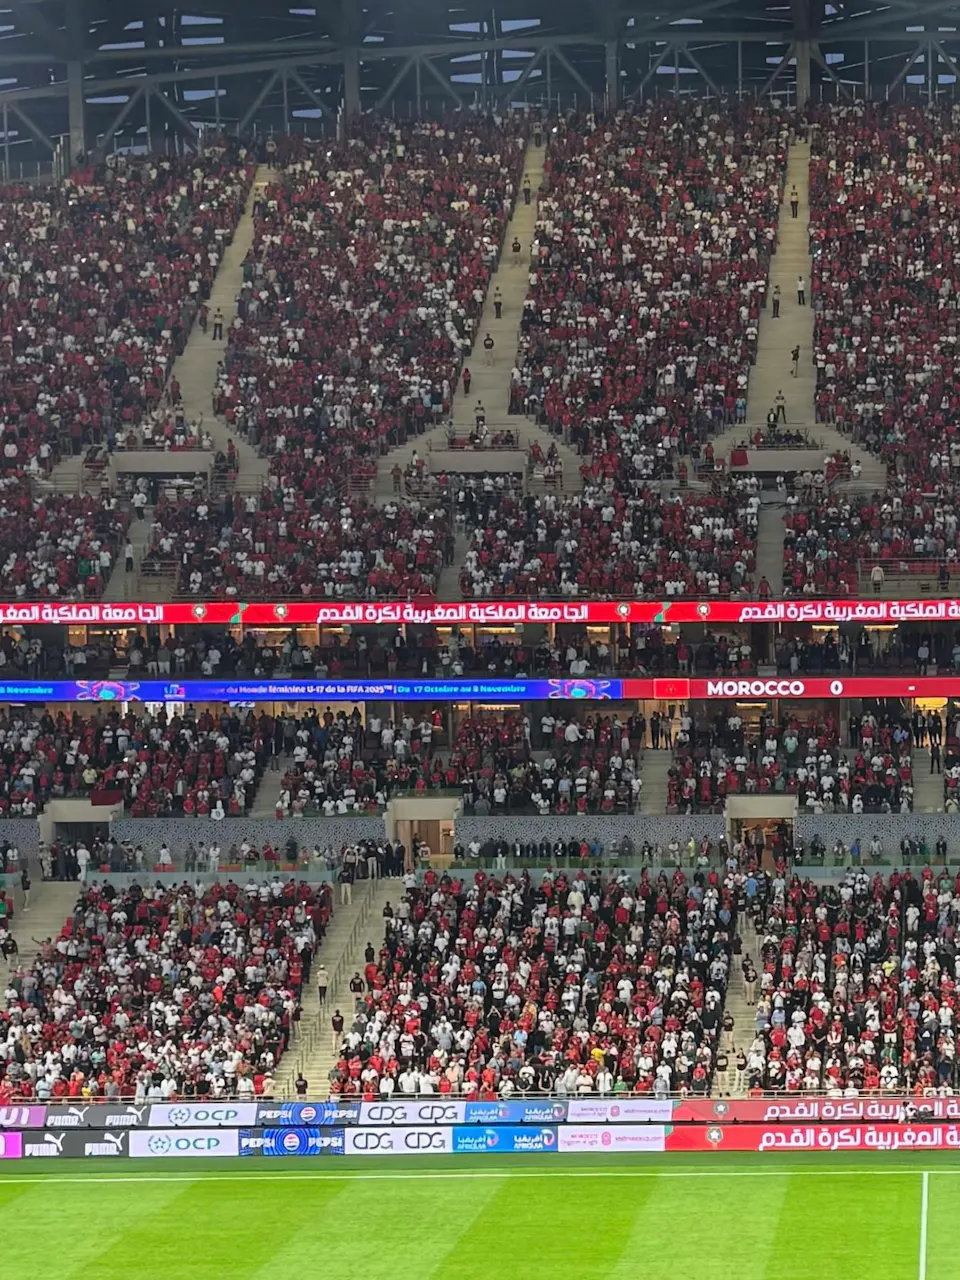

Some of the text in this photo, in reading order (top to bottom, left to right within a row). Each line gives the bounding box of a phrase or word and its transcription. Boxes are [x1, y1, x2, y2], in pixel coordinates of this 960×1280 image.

[707, 681, 805, 696] MOROCCO
[830, 681, 843, 696] 0
[194, 1110, 238, 1121] OCP
[259, 1110, 292, 1119] PEPSI
[324, 1109, 357, 1119] PEPSI
[367, 1106, 407, 1121] CDG
[418, 1105, 458, 1120] CDG
[764, 1102, 818, 1121] القدم
[821, 1101, 863, 1118] لكرة
[175, 1138, 220, 1150] OCP
[241, 1138, 275, 1147] PEPSI
[309, 1138, 343, 1147] PEPSI
[352, 1132, 393, 1150] CDG
[404, 1131, 446, 1149] CDG
[758, 1128, 814, 1151] القدم
[818, 1127, 861, 1147] لكرة
[865, 1126, 943, 1150] المغربية
